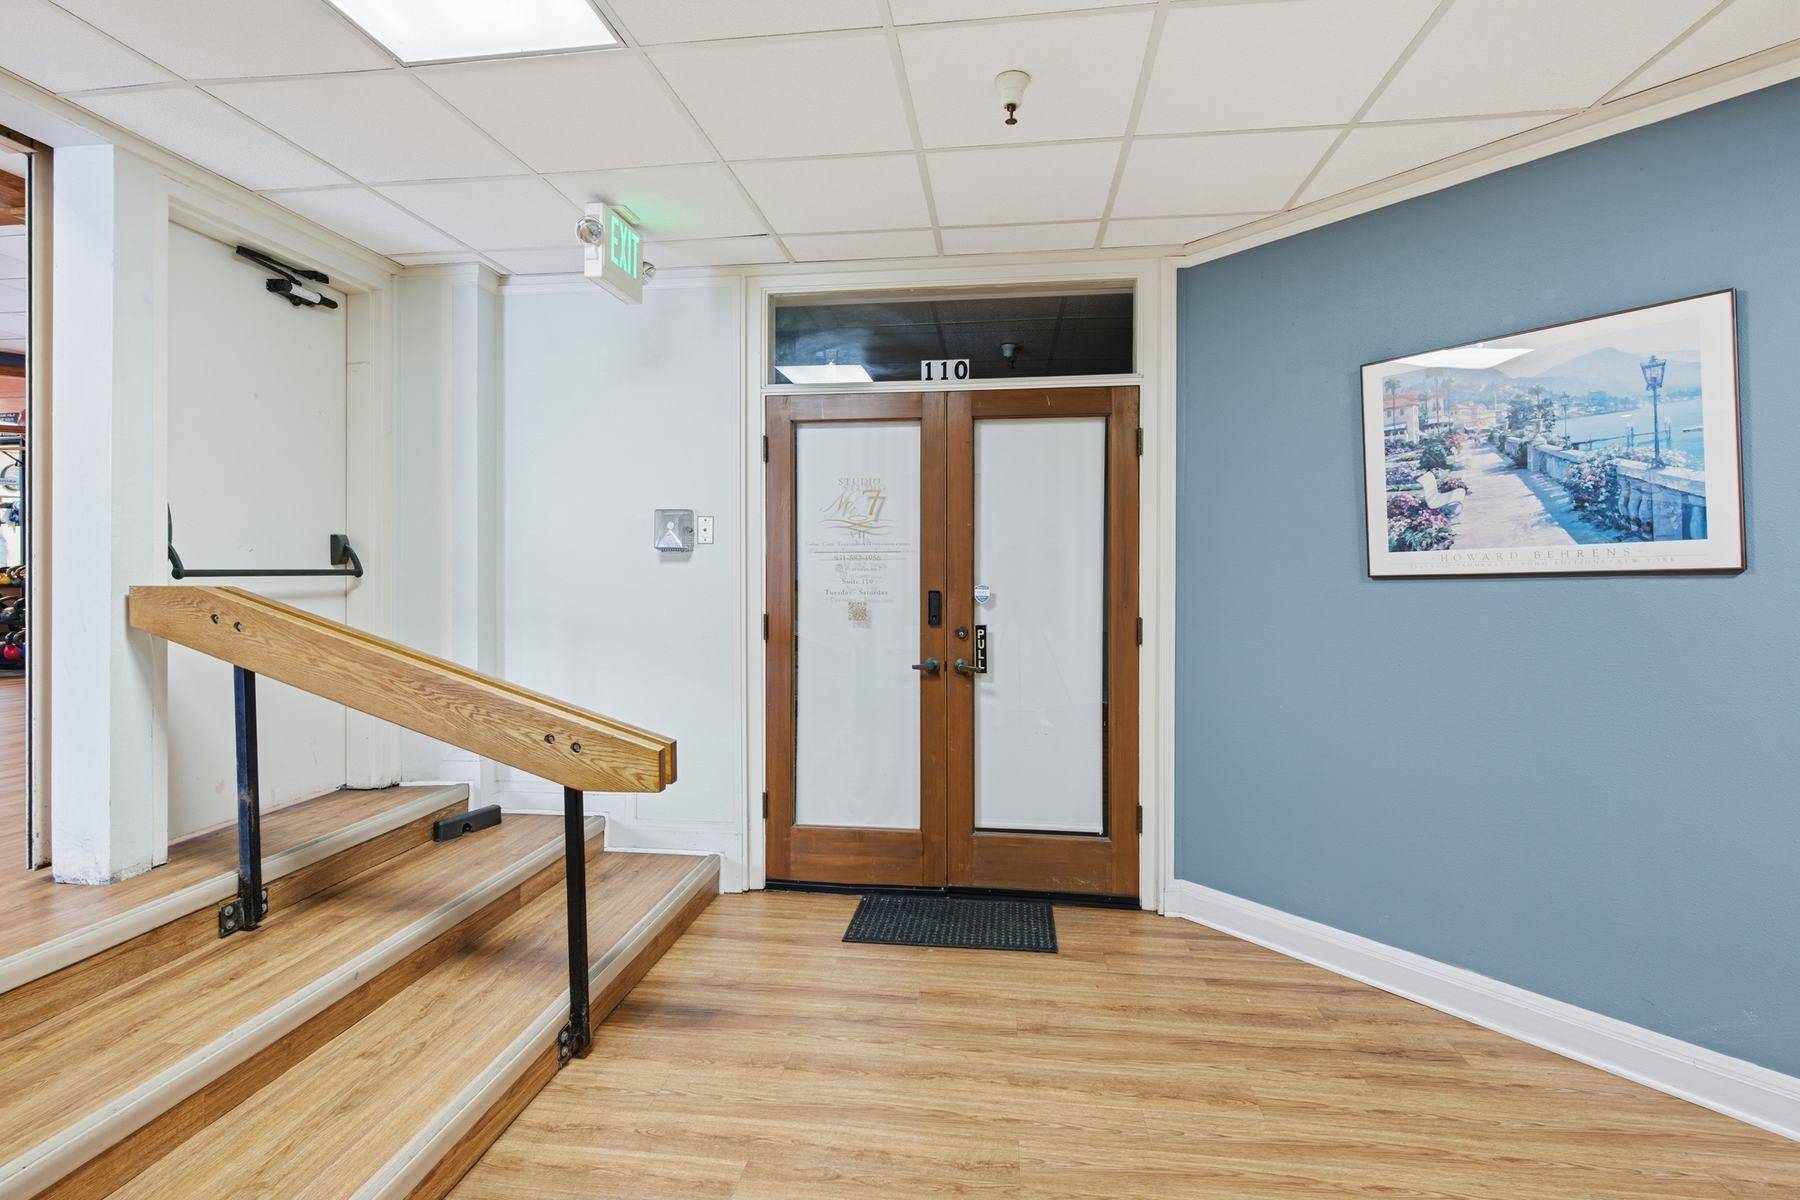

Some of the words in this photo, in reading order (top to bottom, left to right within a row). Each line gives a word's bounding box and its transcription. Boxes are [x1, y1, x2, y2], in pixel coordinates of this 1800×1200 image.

[610, 215, 640, 280] EXIT
[925, 361, 968, 381] 110
[1440, 551, 1519, 562] HOWARD
[1533, 547, 1631, 559] BEHRENS
[977, 629, 985, 669] PULL
